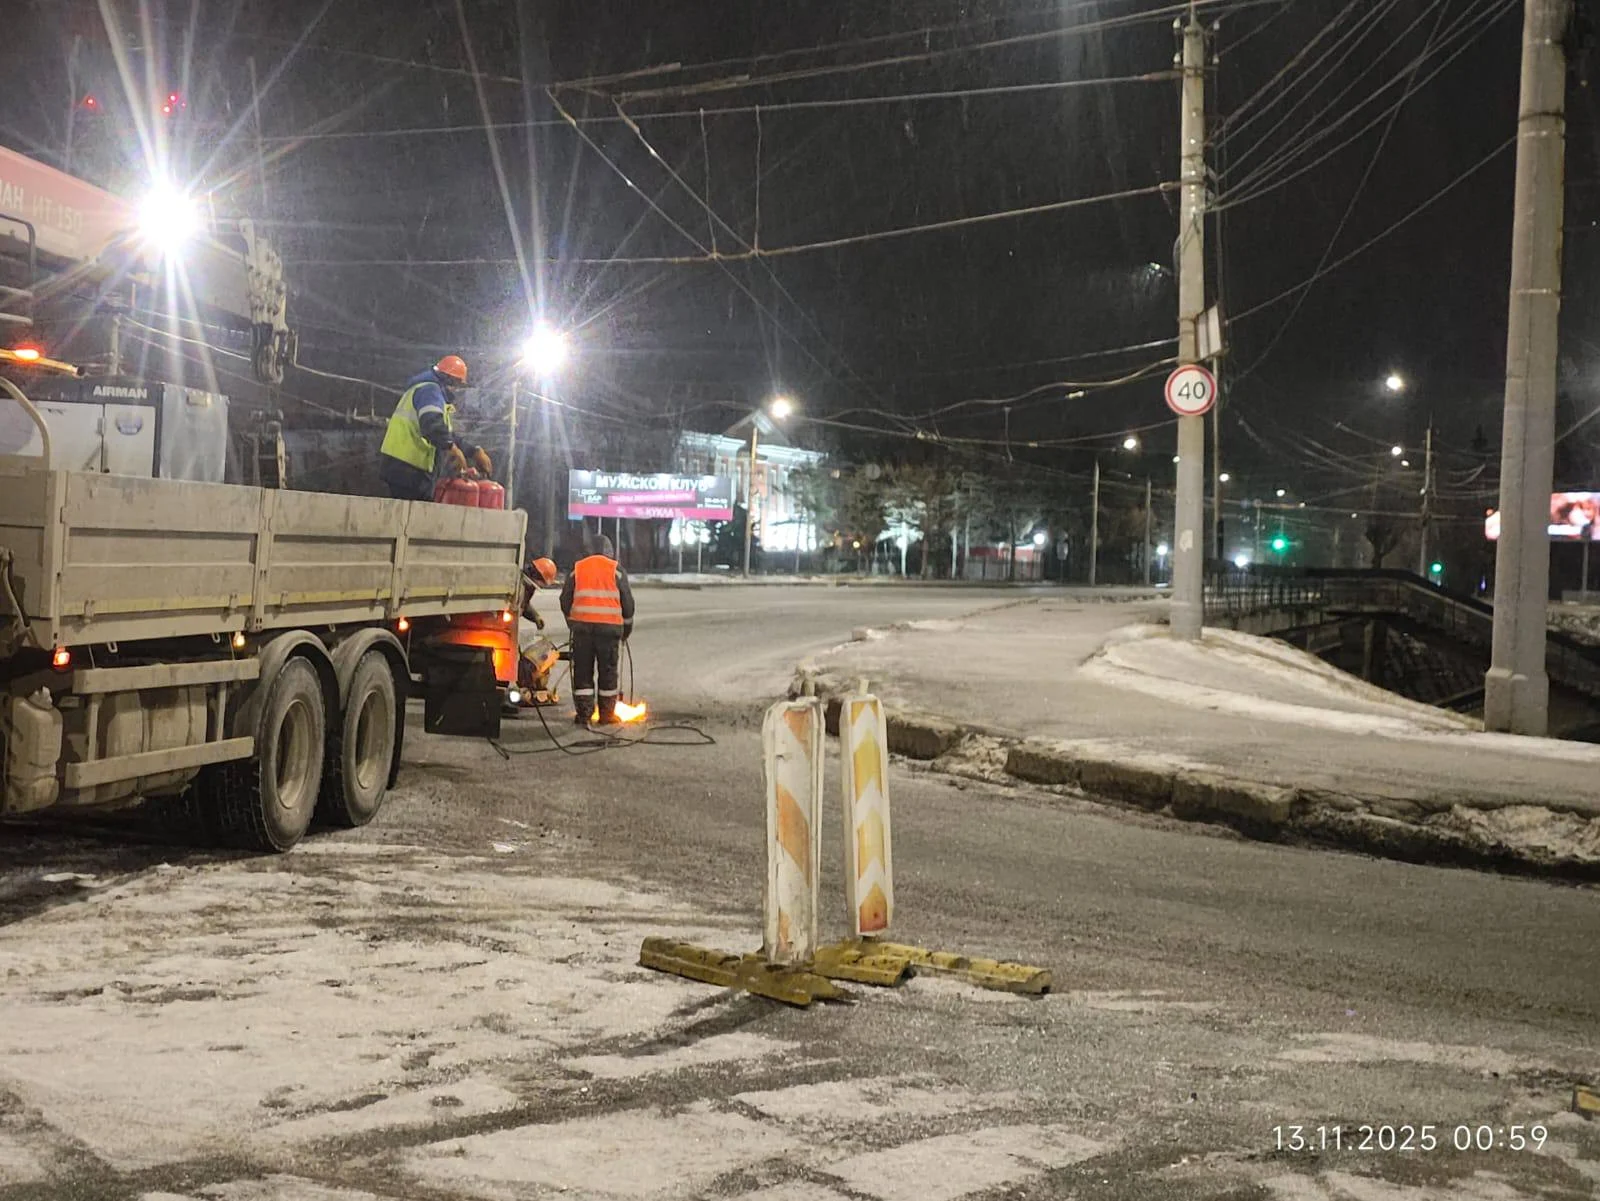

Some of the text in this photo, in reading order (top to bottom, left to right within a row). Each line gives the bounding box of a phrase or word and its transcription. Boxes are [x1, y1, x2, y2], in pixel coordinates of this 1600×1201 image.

[0, 178, 24, 213] АН
[93, 385, 148, 399] AIRMAN
[1178, 382, 1206, 400] 40
